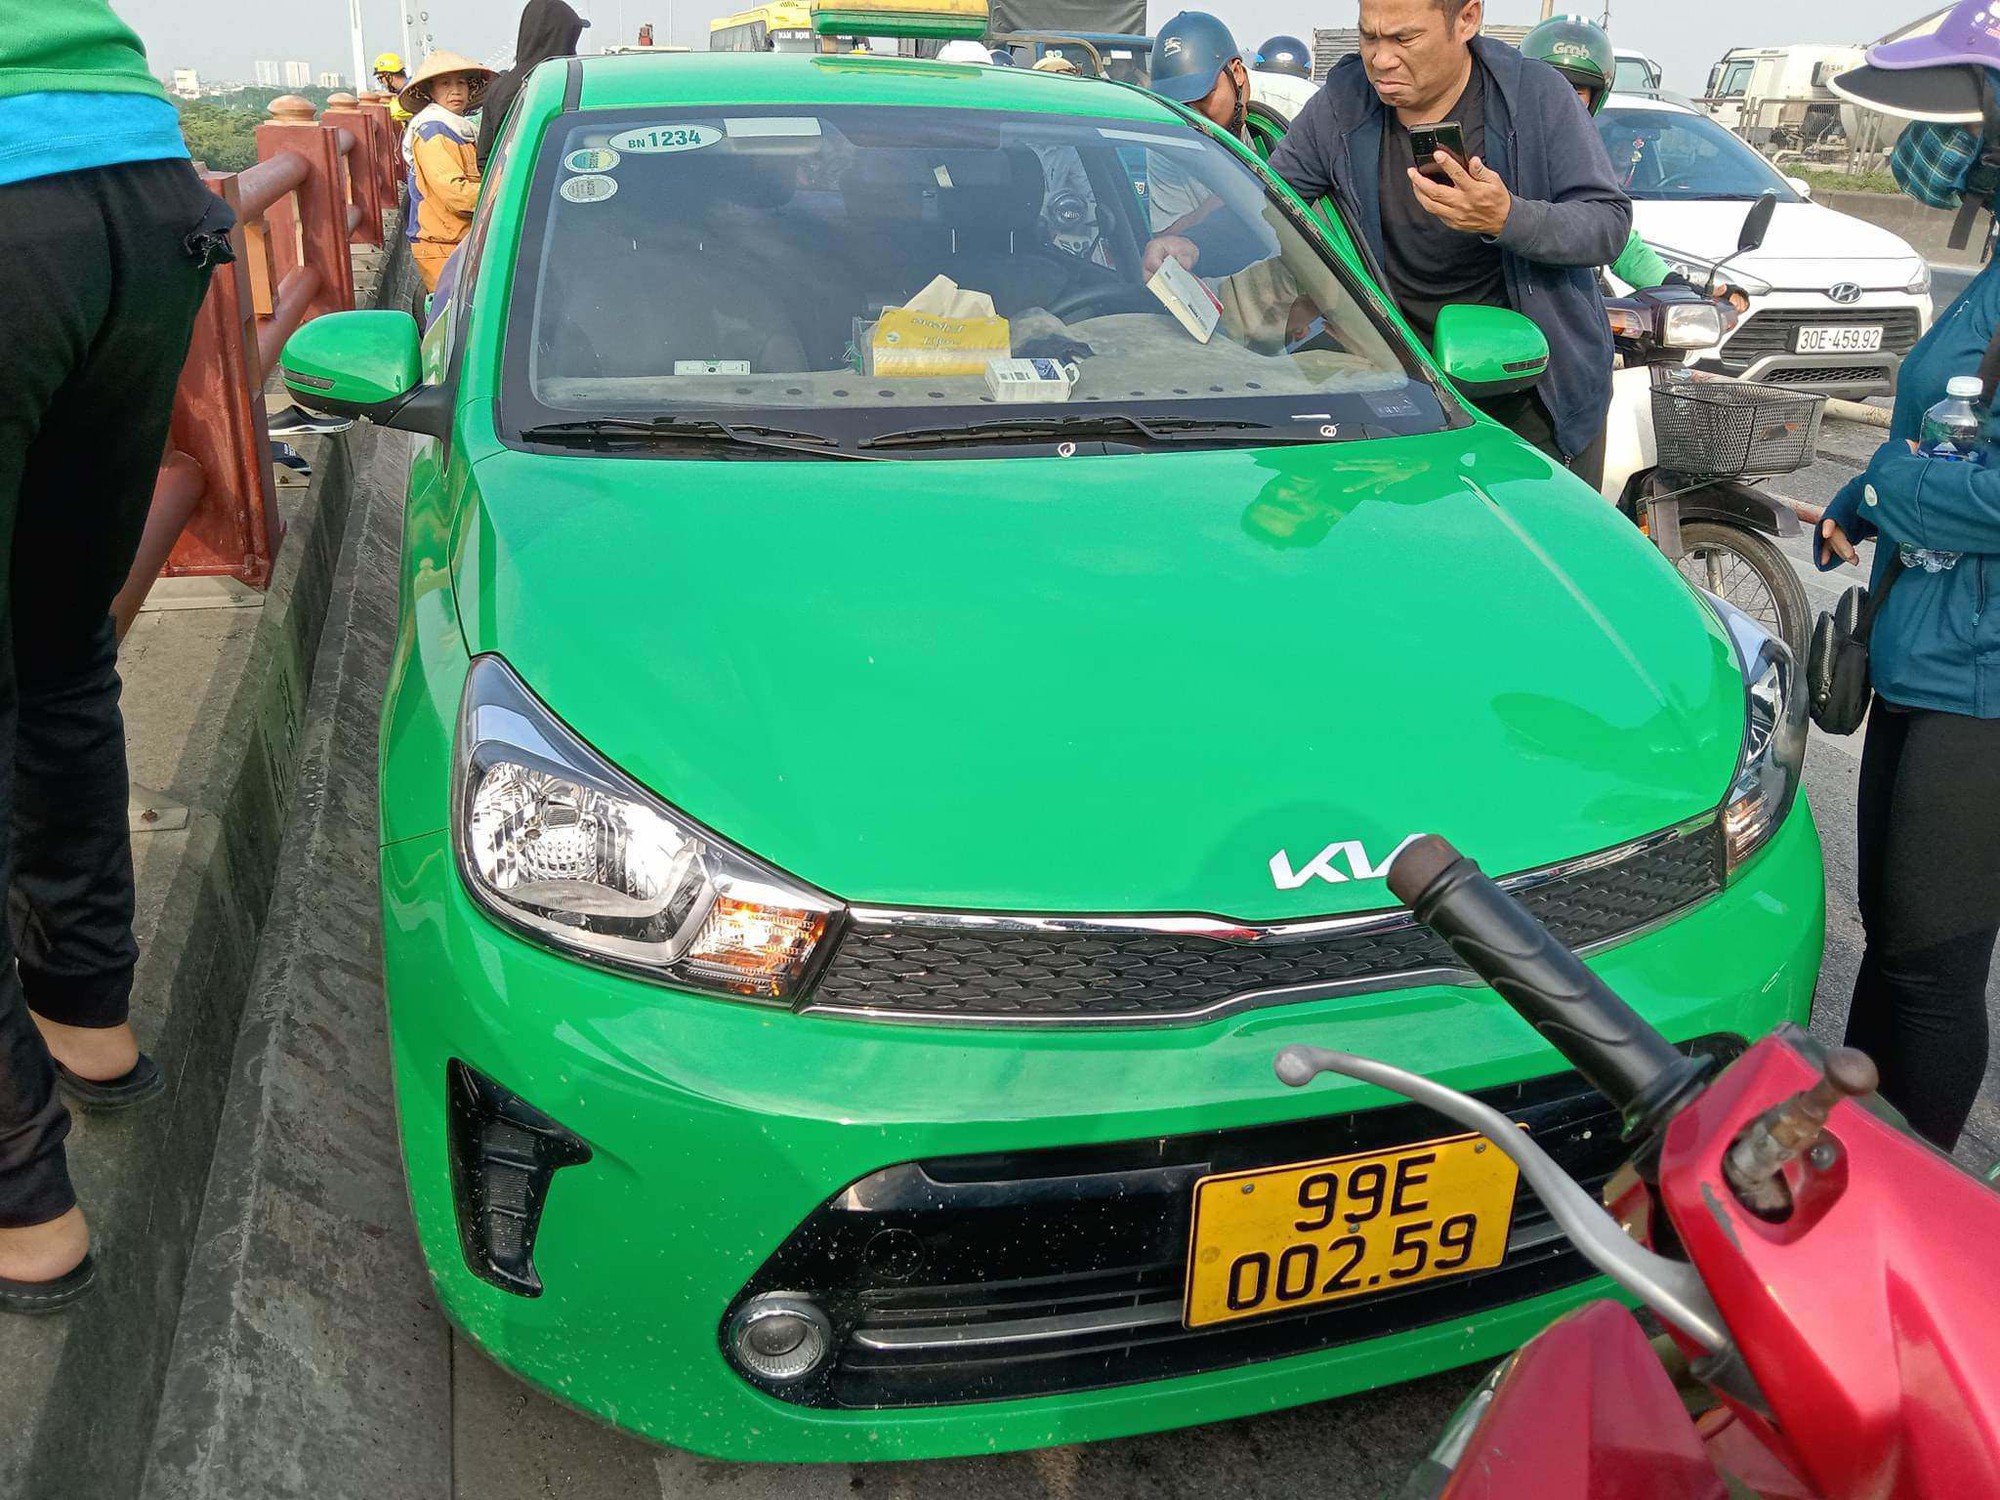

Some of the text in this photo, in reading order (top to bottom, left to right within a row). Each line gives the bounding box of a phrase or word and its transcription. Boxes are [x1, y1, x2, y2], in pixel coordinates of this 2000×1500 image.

[1553, 42, 1590, 58] Grab
[628, 129, 701, 148] BN 1234
[1294, 1153, 1437, 1233] 99E
[1226, 1213, 1477, 1311] 002.59
